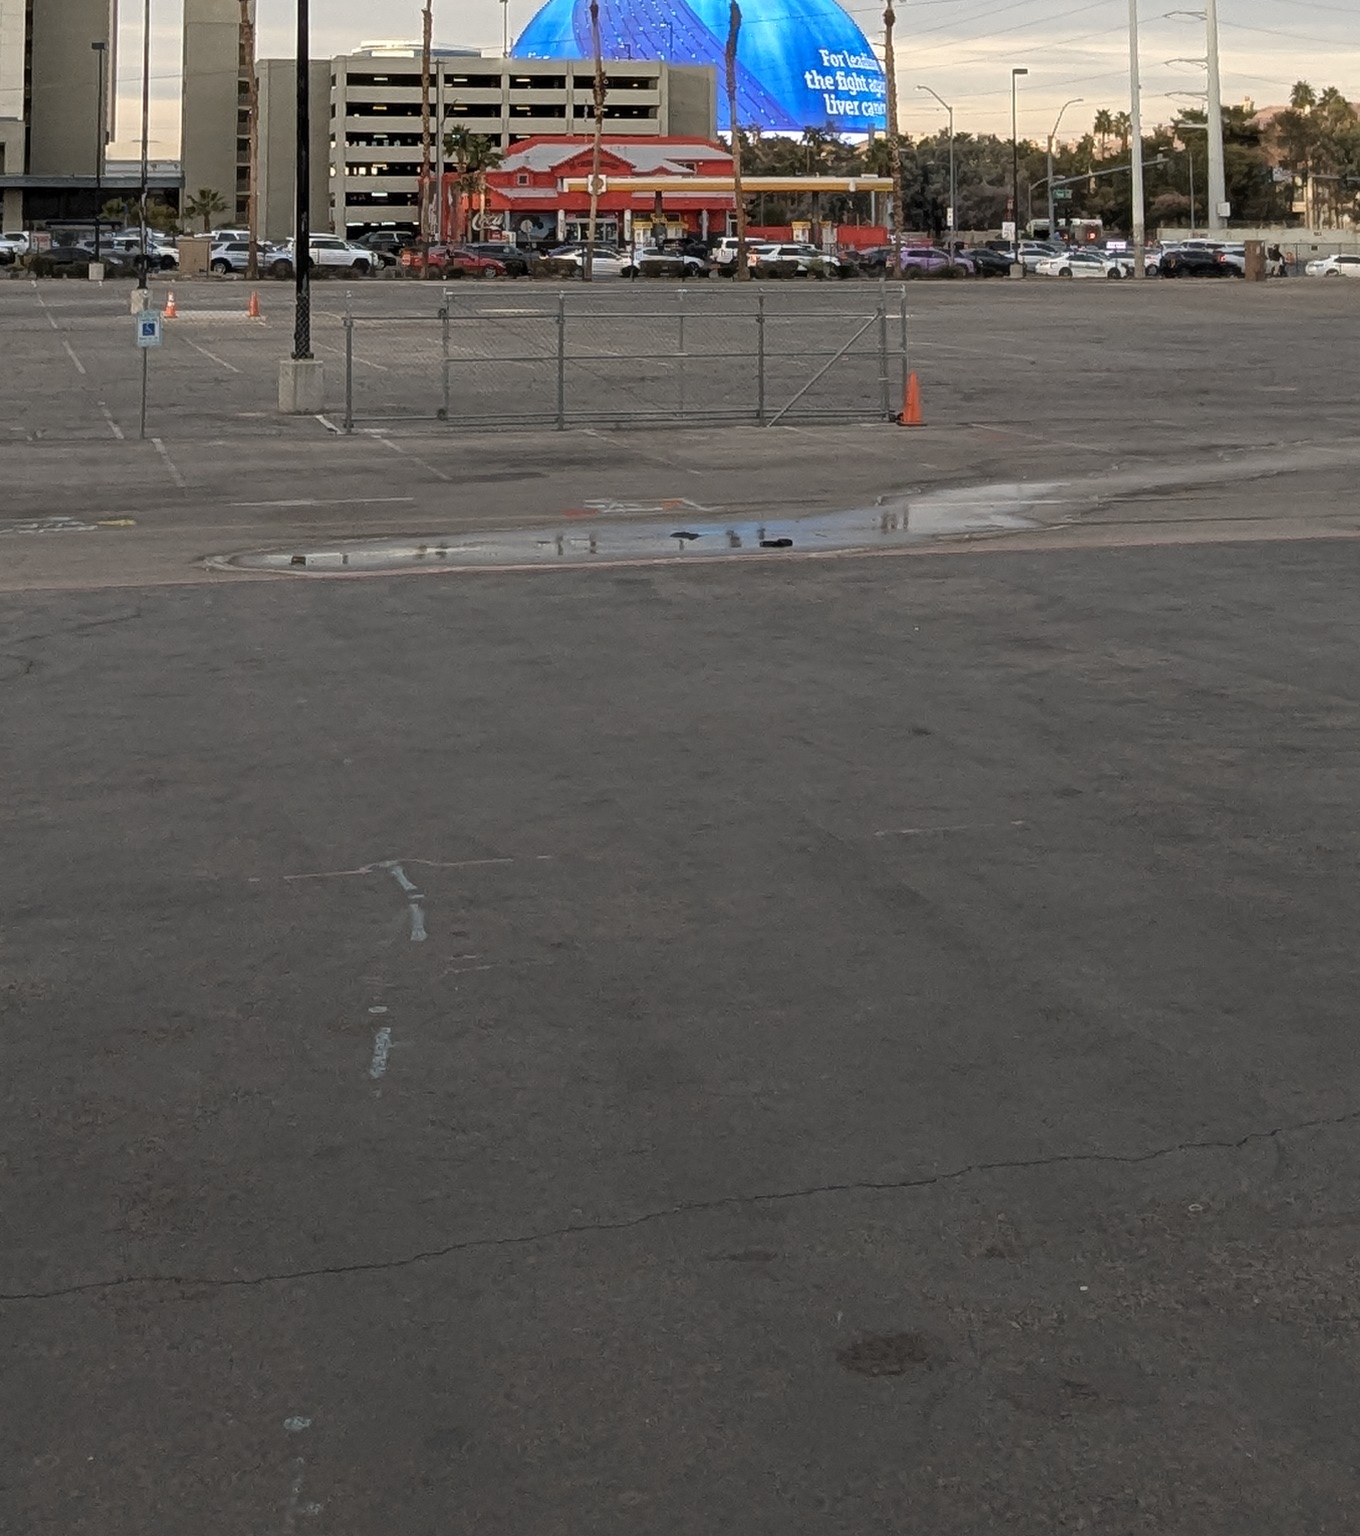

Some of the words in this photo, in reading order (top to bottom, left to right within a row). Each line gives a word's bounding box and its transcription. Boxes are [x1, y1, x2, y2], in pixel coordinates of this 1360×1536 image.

[818, 49, 846, 68] For
[804, 69, 835, 90] the
[835, 70, 869, 96] fight
[823, 92, 860, 116] liver
